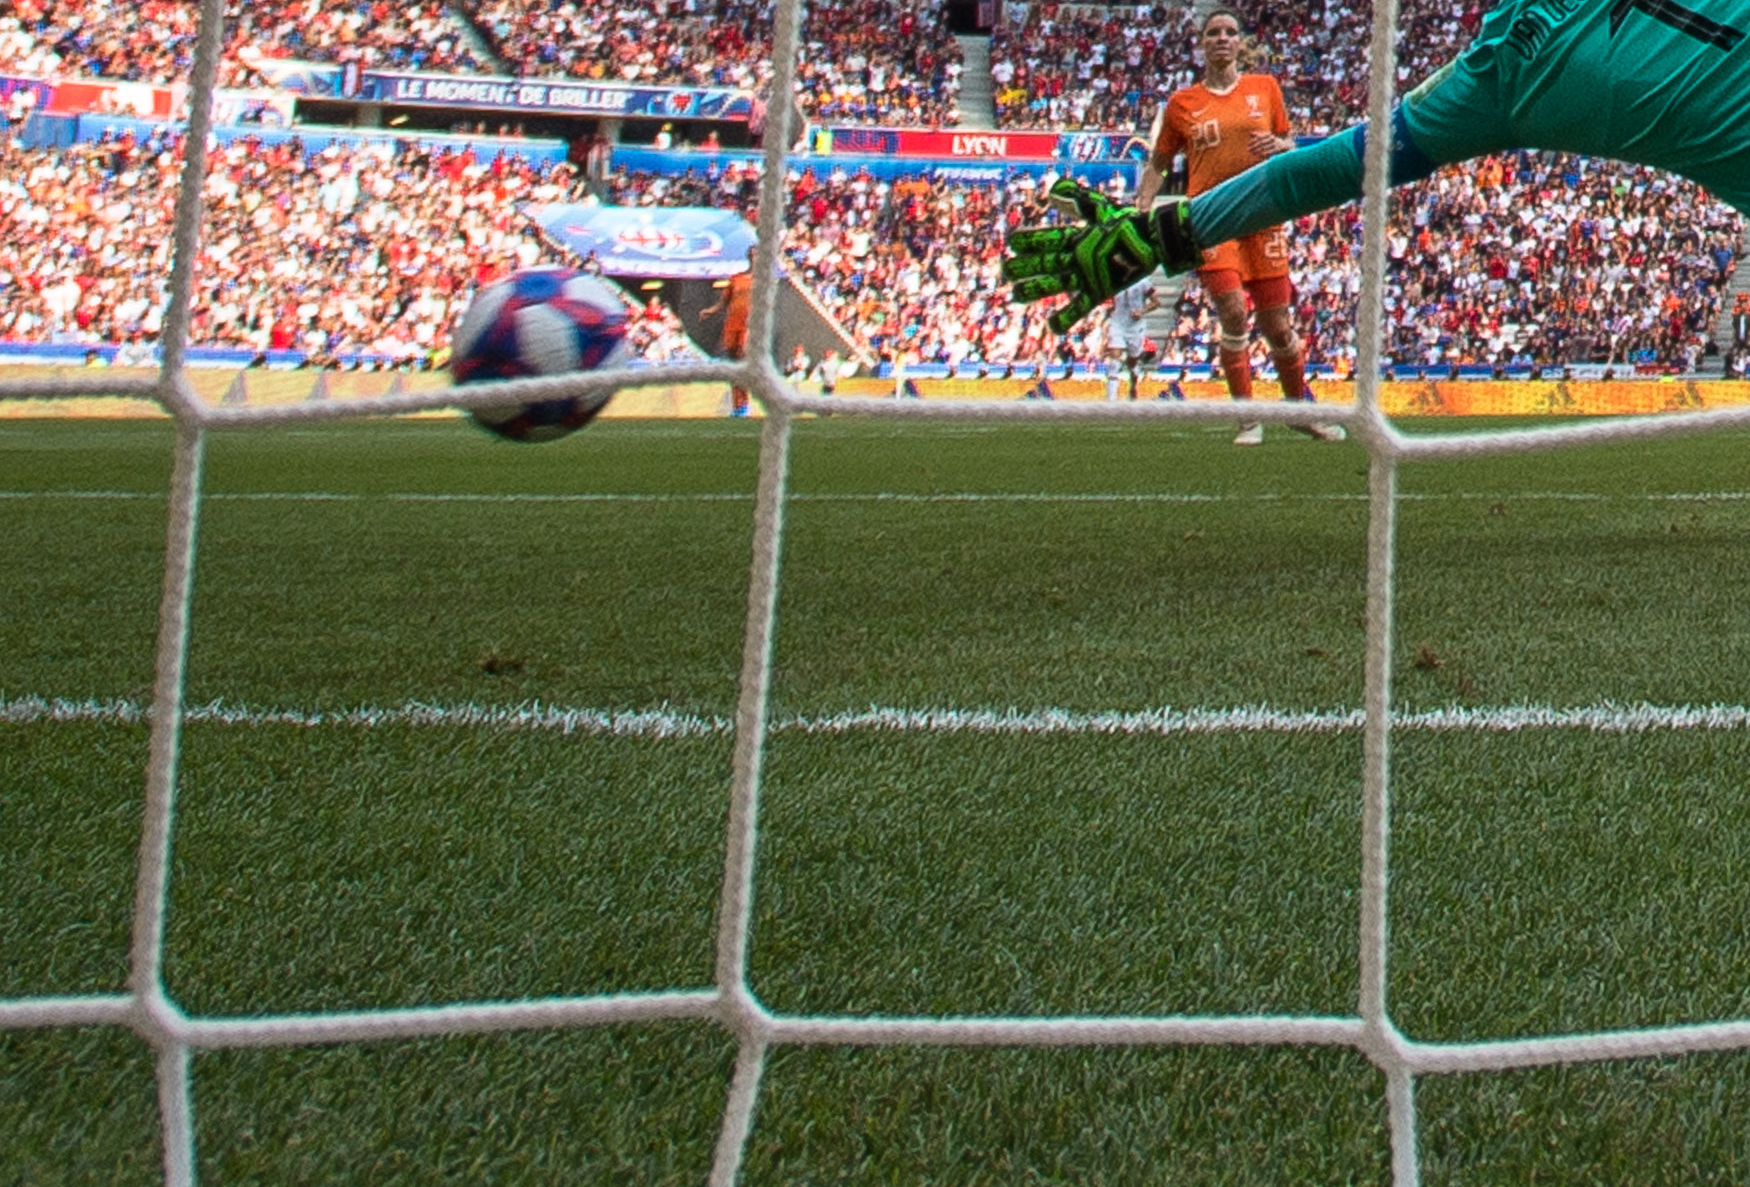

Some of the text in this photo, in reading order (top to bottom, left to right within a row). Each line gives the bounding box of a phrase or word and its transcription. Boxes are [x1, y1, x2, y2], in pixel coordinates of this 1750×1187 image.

[397, 78, 424, 99] LE
[518, 86, 547, 106] DE
[951, 135, 1007, 156] LYON
